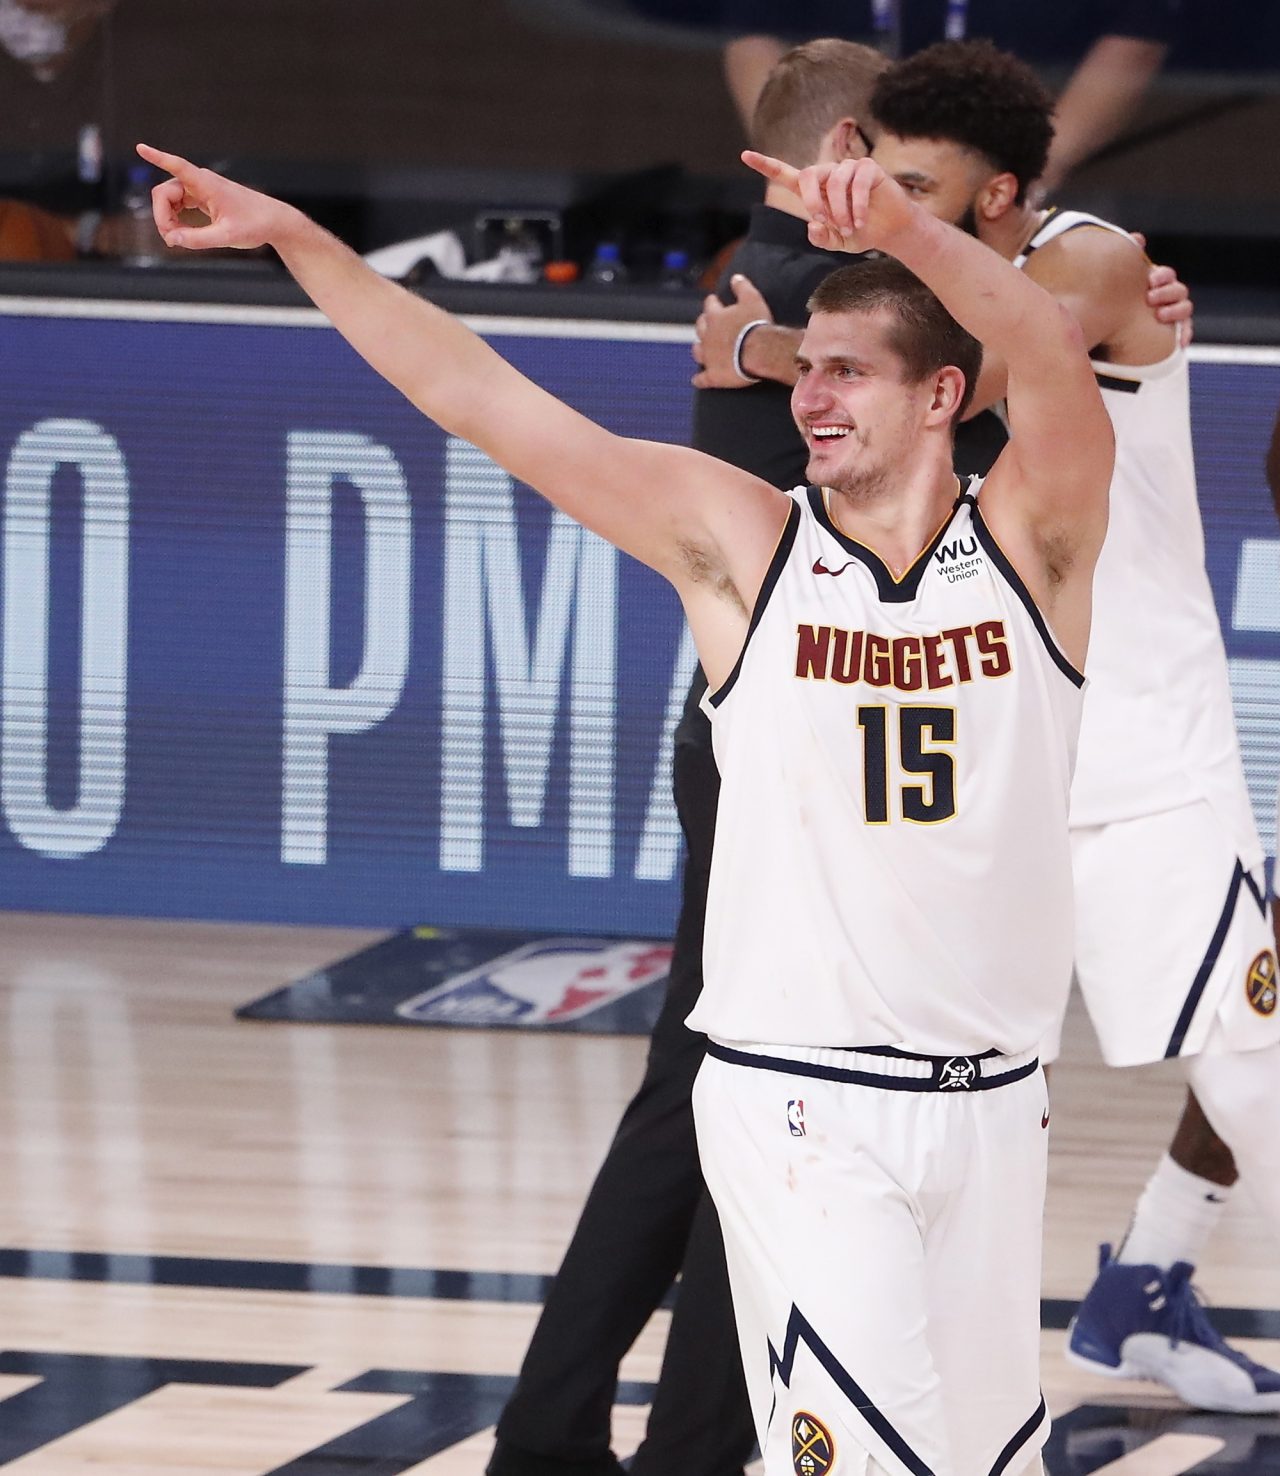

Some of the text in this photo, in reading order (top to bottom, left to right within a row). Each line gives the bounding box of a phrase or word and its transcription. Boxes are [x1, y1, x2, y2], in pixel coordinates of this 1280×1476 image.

[934, 536, 978, 564] WU
[936, 557, 983, 576] Western
[947, 568, 979, 584] Union
[794, 619, 1014, 693] NUGGETS
[856, 703, 959, 826] 15
